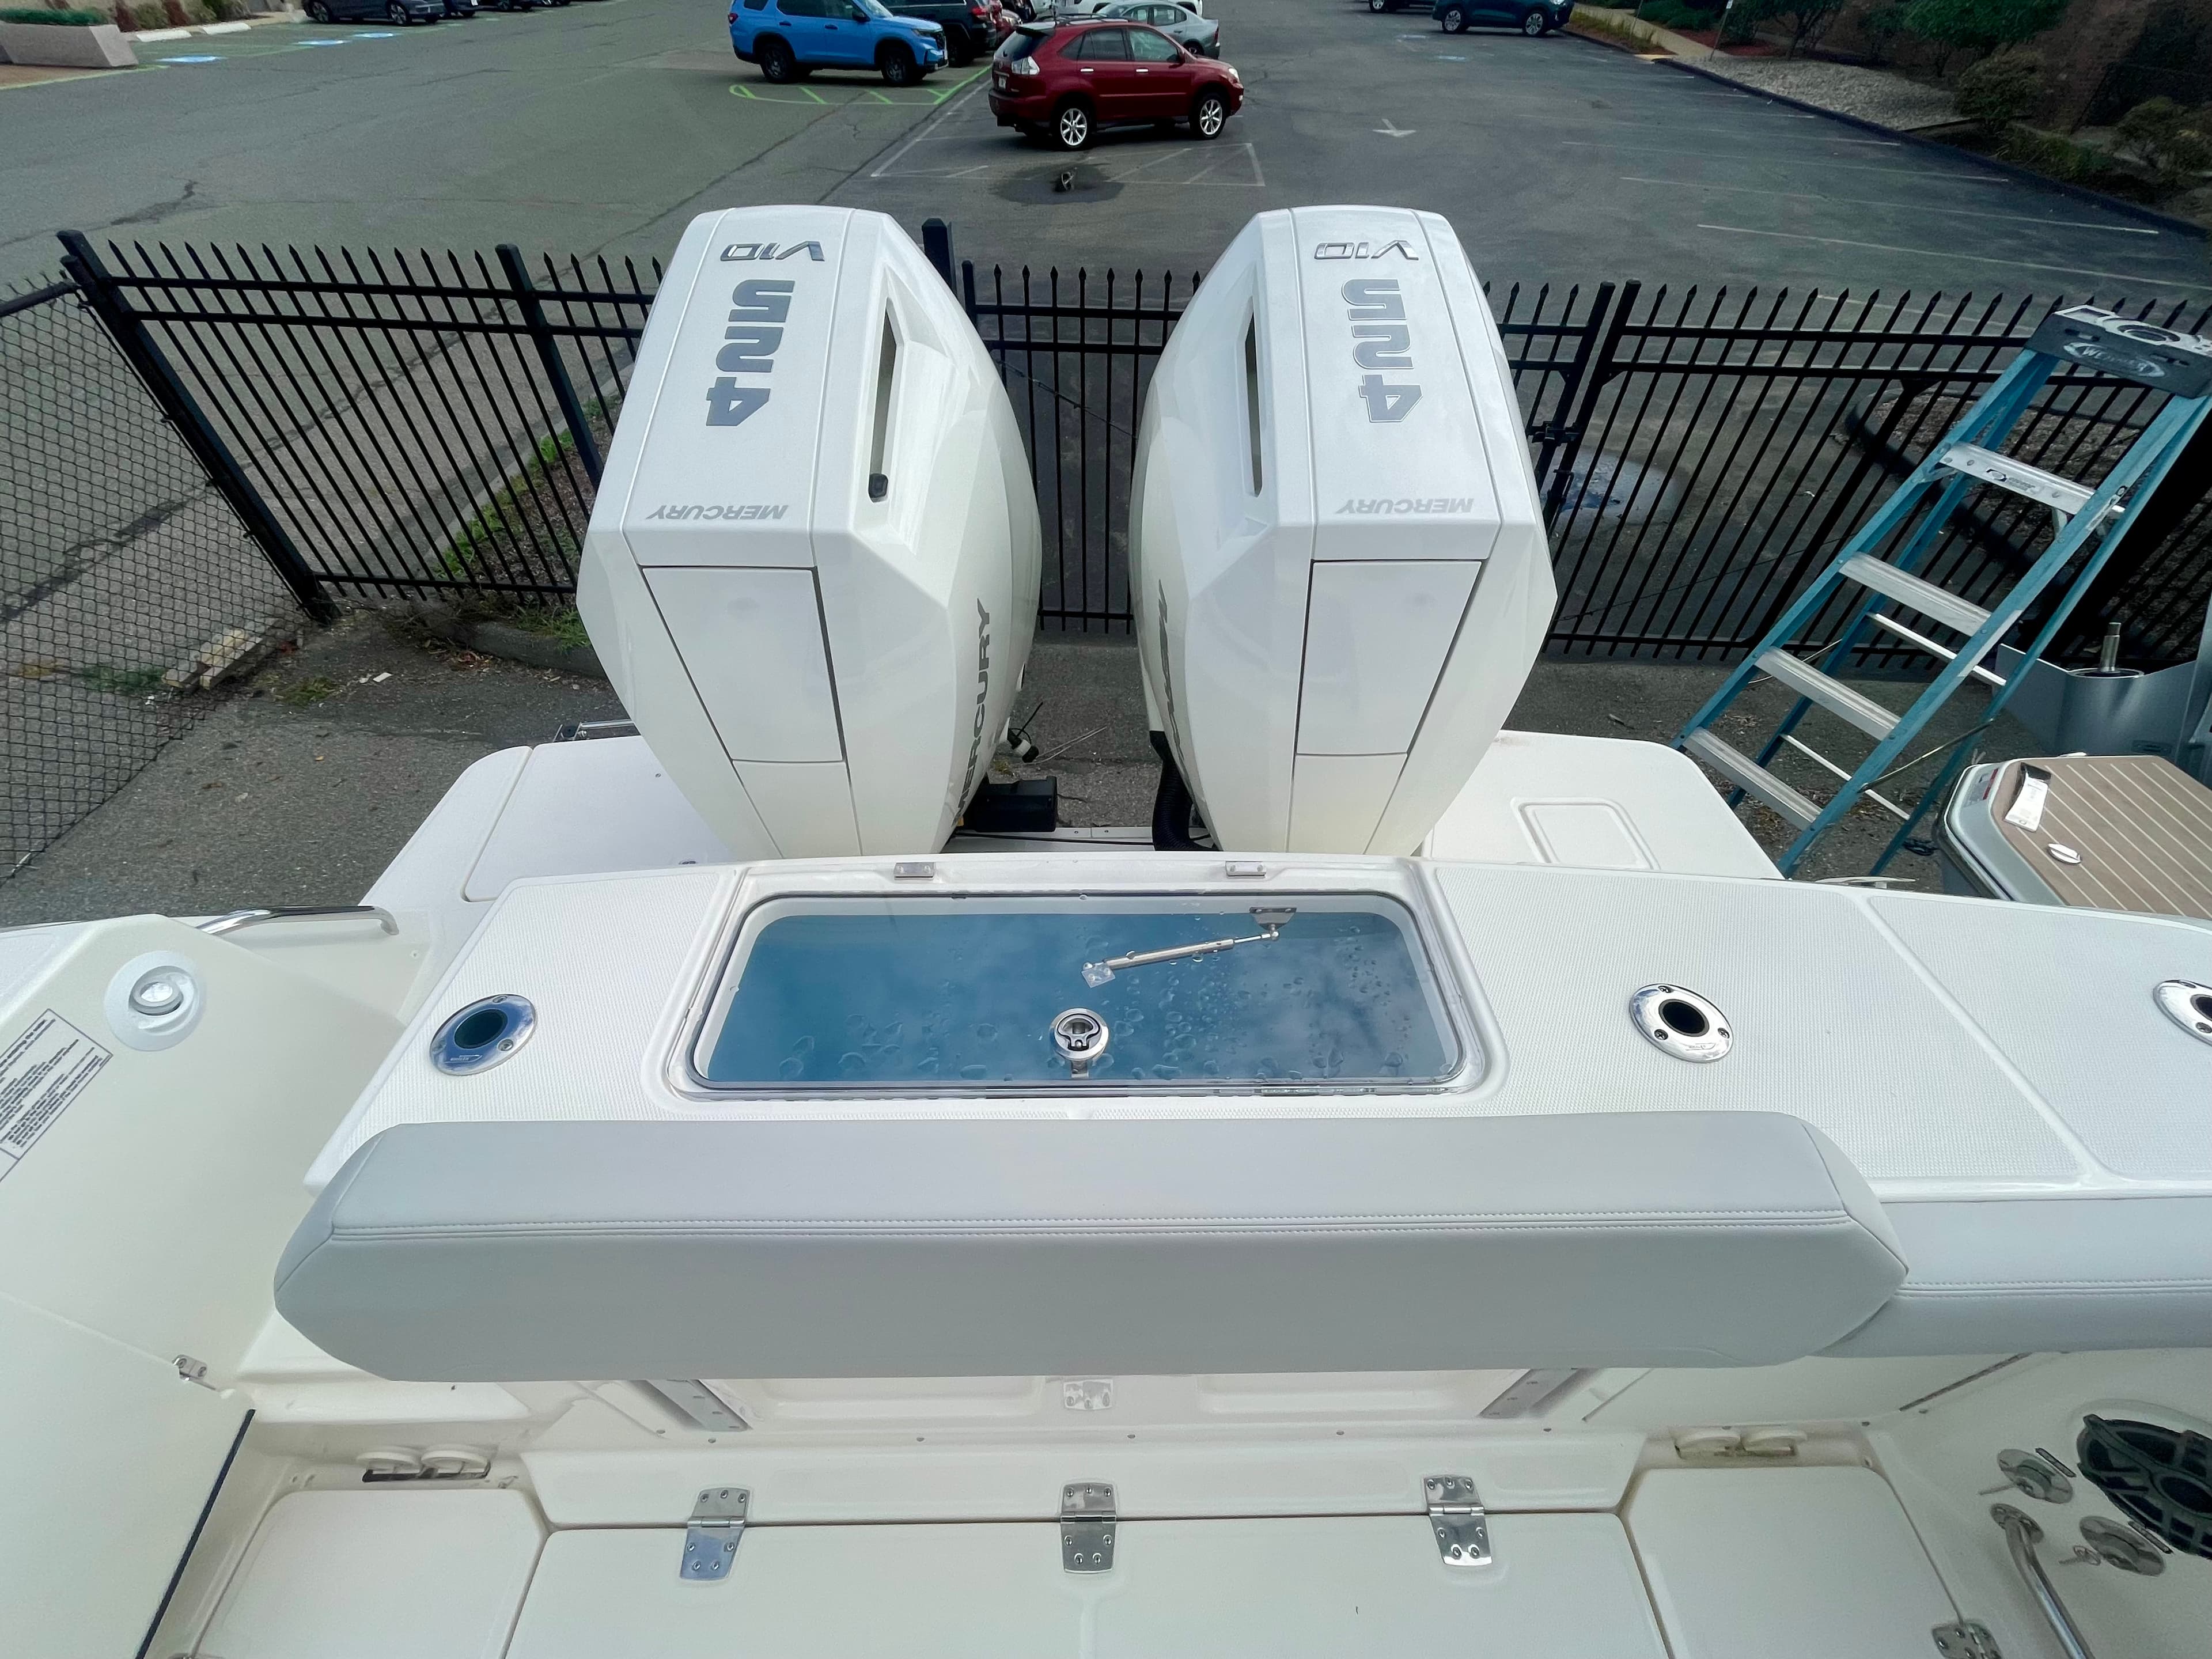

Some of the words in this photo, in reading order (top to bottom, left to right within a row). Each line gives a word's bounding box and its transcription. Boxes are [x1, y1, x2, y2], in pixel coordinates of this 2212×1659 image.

[721, 241, 824, 261] V10
[1314, 240, 1419, 260] V10
[706, 279, 796, 426] 425
[1341, 279, 1423, 423] 425
[647, 505, 789, 520] MERCURY
[1336, 498, 1474, 513] MERCURY
[951, 597, 990, 828] MERCURY
